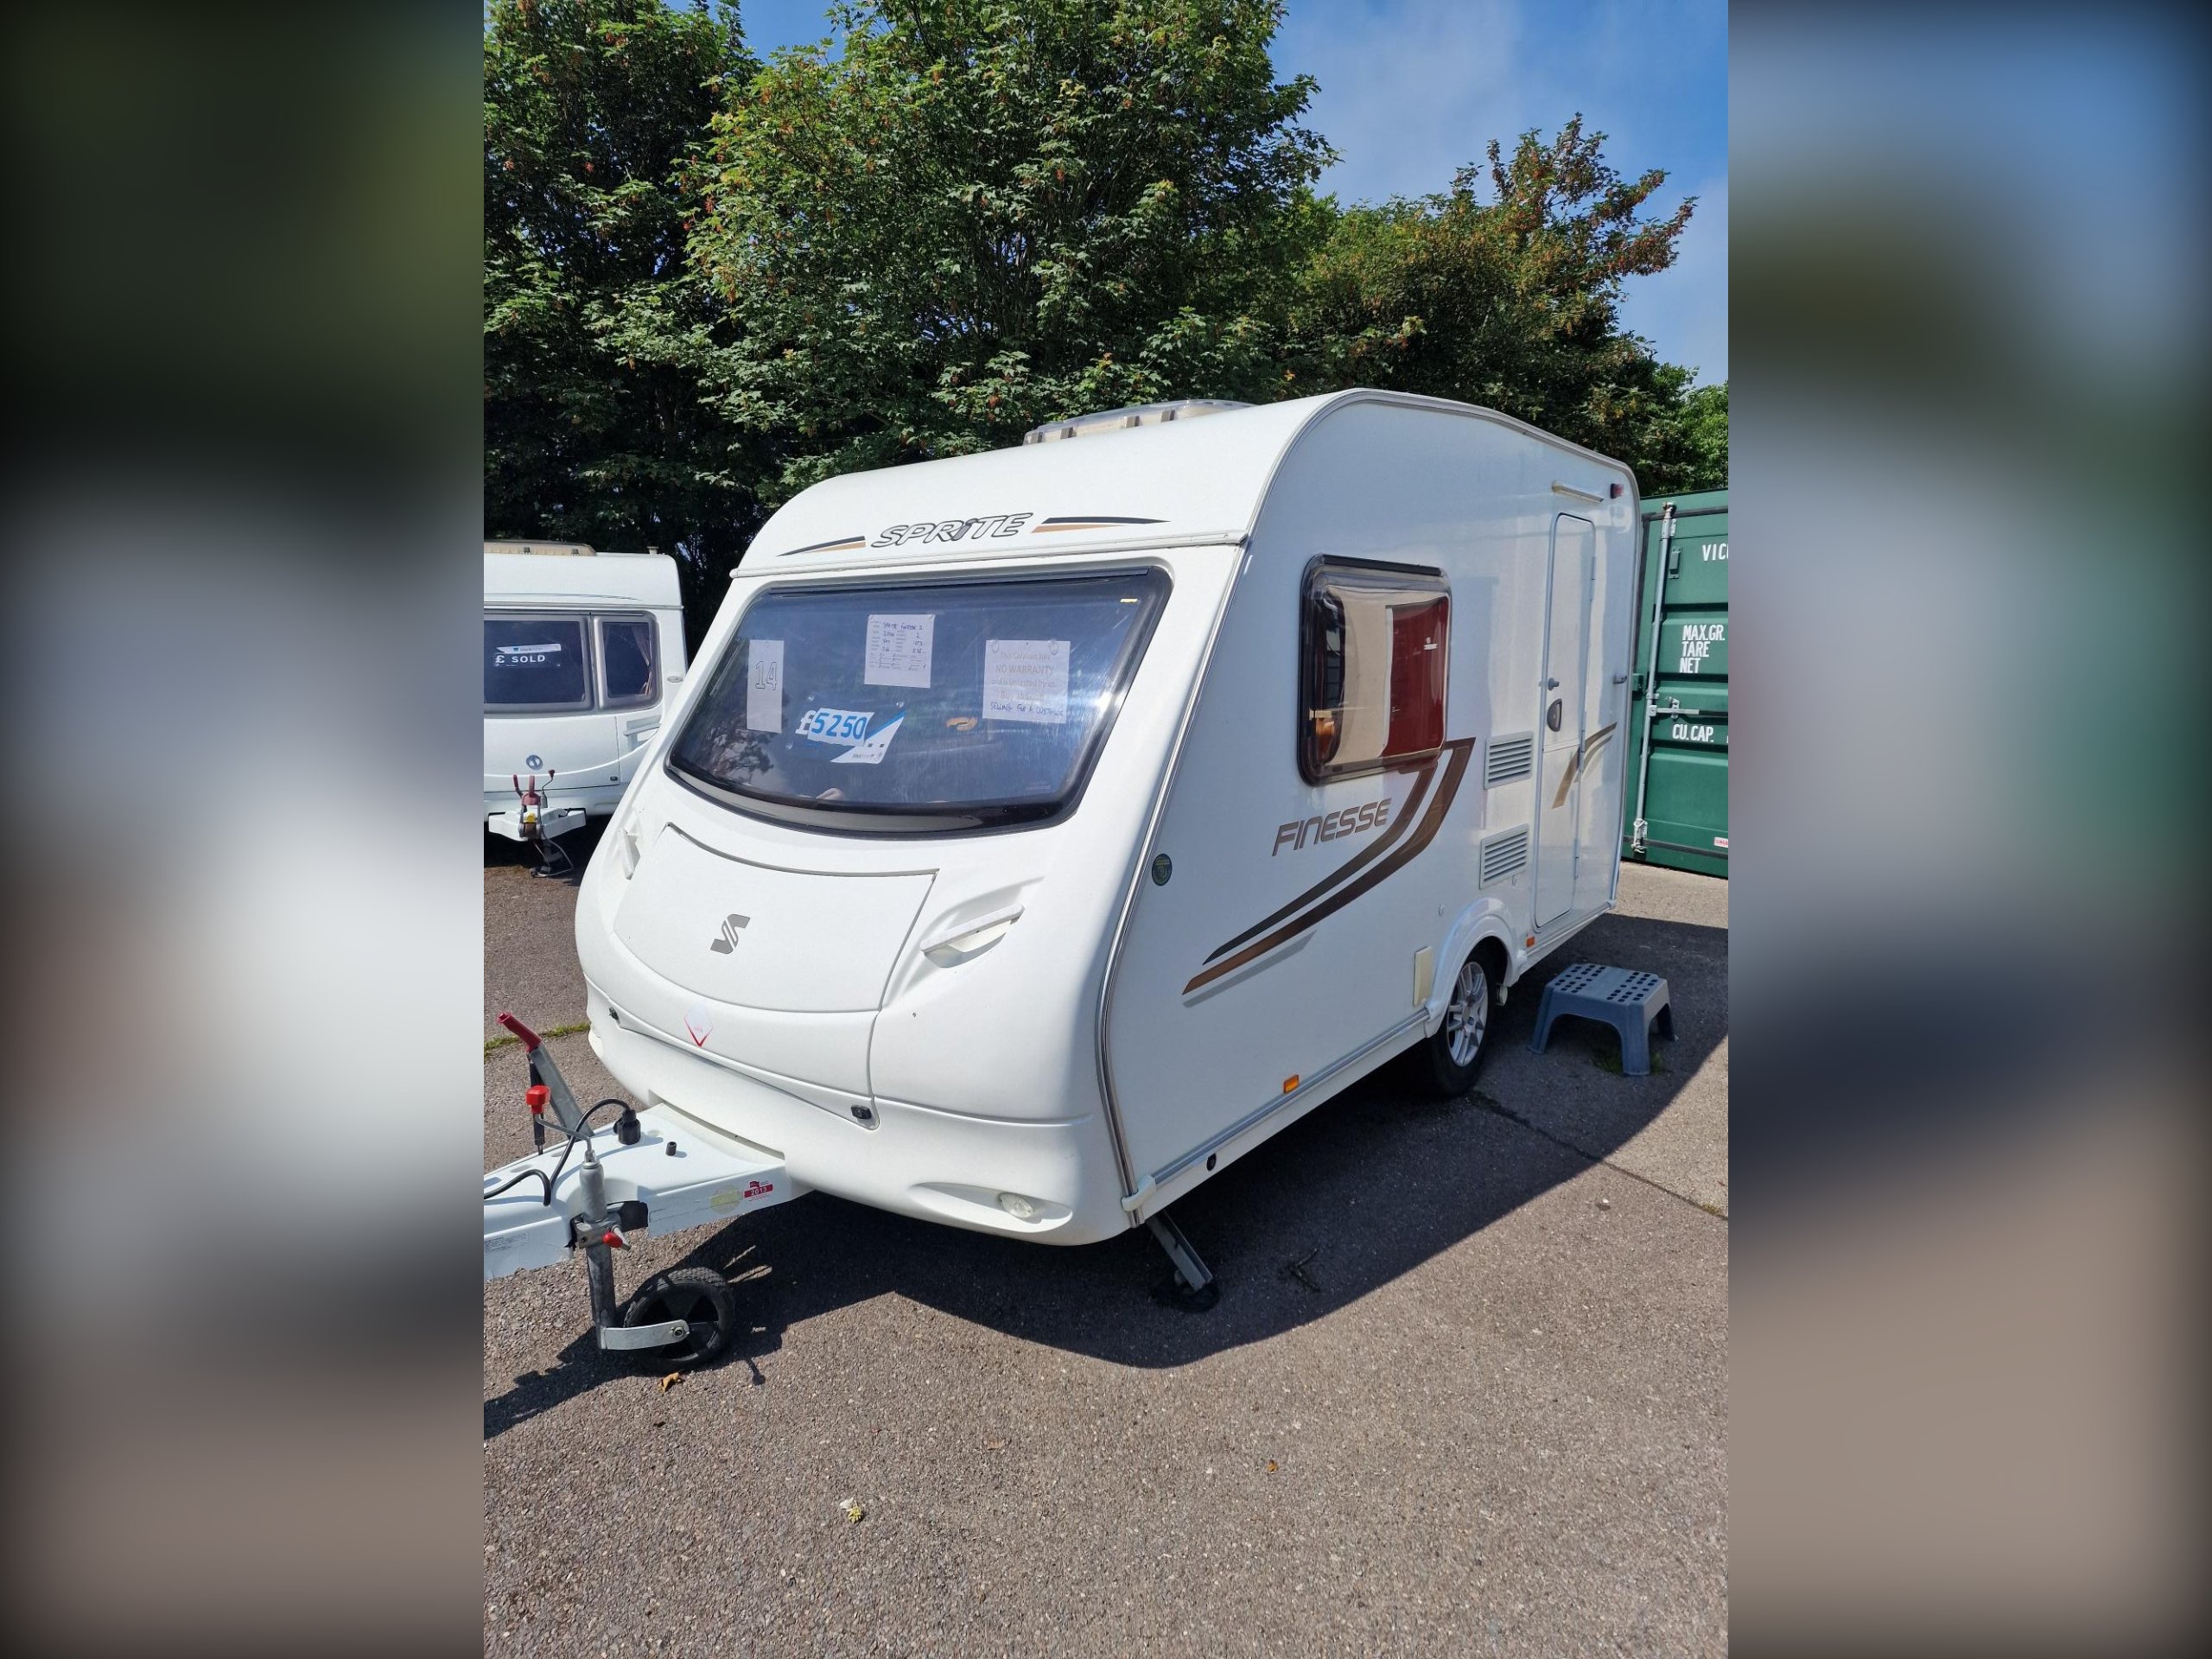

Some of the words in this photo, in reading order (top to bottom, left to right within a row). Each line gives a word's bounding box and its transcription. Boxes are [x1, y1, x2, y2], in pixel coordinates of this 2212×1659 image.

[870, 512, 1033, 548] SPRITE
[1681, 641, 1711, 658] TARE
[495, 655, 505, 664] £
[512, 654, 546, 664] SOLD
[1679, 658, 1701, 674] NET
[754, 661, 778, 691] 14
[995, 664, 1007, 673] NO
[1008, 664, 1054, 675] WARRANTY
[1272, 798, 1393, 857] FINESSE
